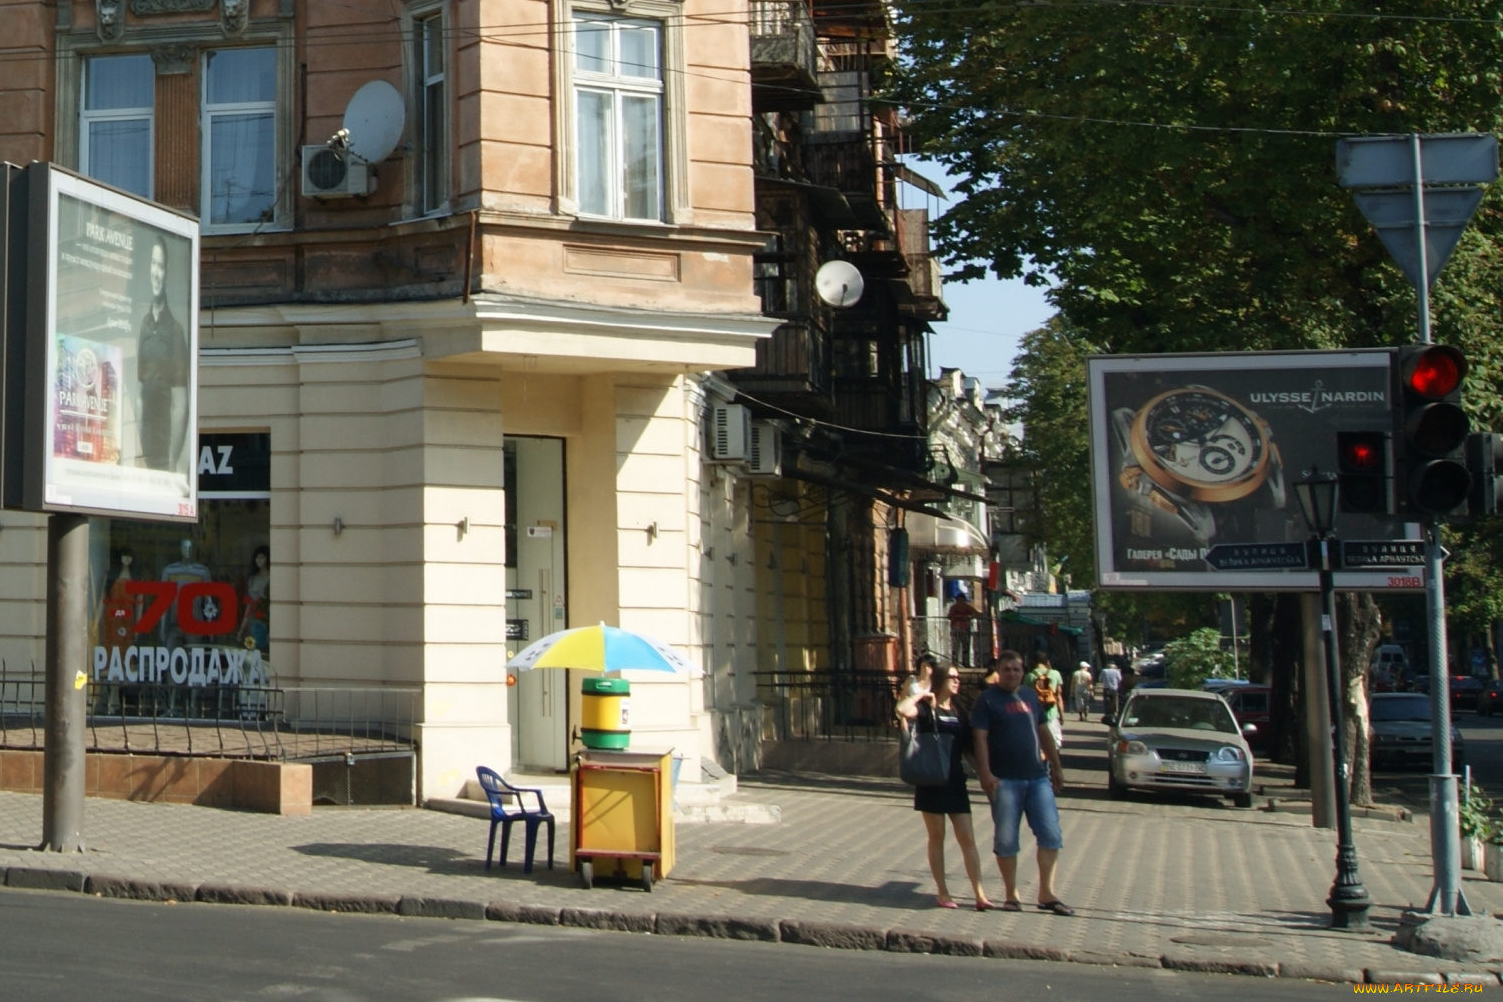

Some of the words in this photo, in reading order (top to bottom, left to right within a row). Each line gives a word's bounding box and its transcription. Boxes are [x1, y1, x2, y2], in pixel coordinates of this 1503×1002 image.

[1250, 392, 1311, 403] ULYSSE
[1321, 391, 1385, 402] NARDIN
[94, 646, 265, 687] РАСПРОДАЖА
